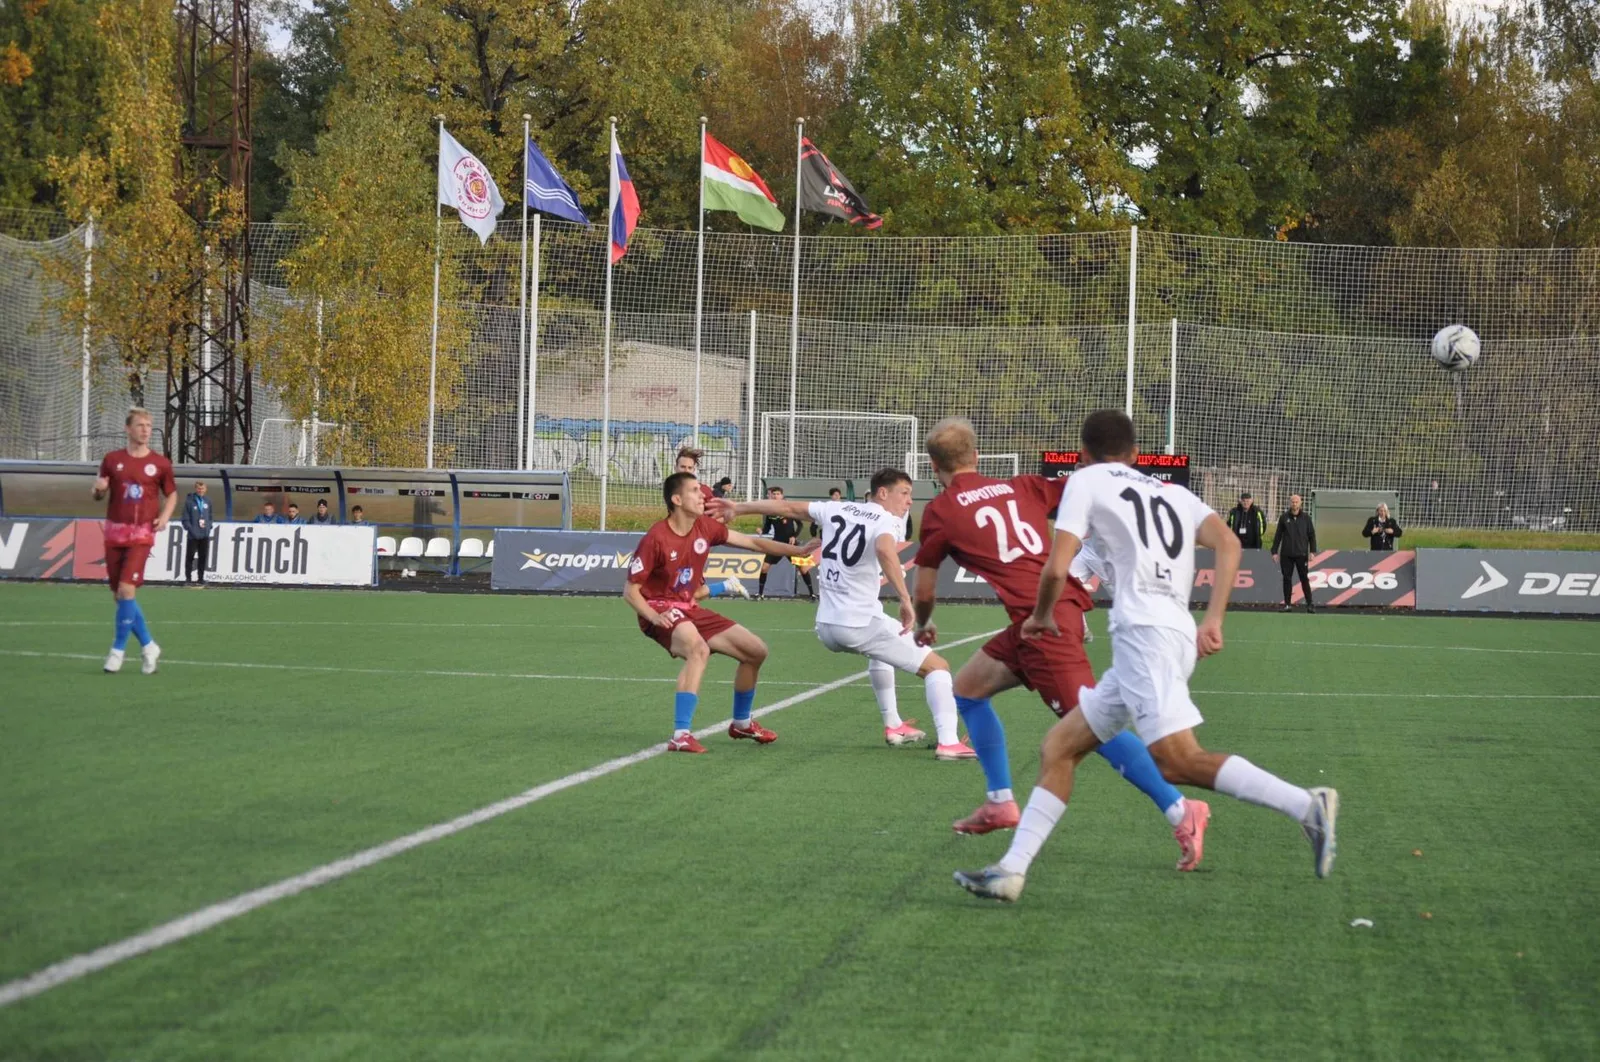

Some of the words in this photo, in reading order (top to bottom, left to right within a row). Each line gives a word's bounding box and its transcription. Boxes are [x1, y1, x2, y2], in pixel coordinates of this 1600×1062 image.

[822, 514, 866, 567] 20
[975, 500, 1044, 564] 26
[1120, 486, 1184, 560] 10
[166, 525, 220, 579] Rd
[231, 526, 309, 574] finch
[704, 557, 762, 574] PRO
[1307, 571, 1398, 590] 2026
